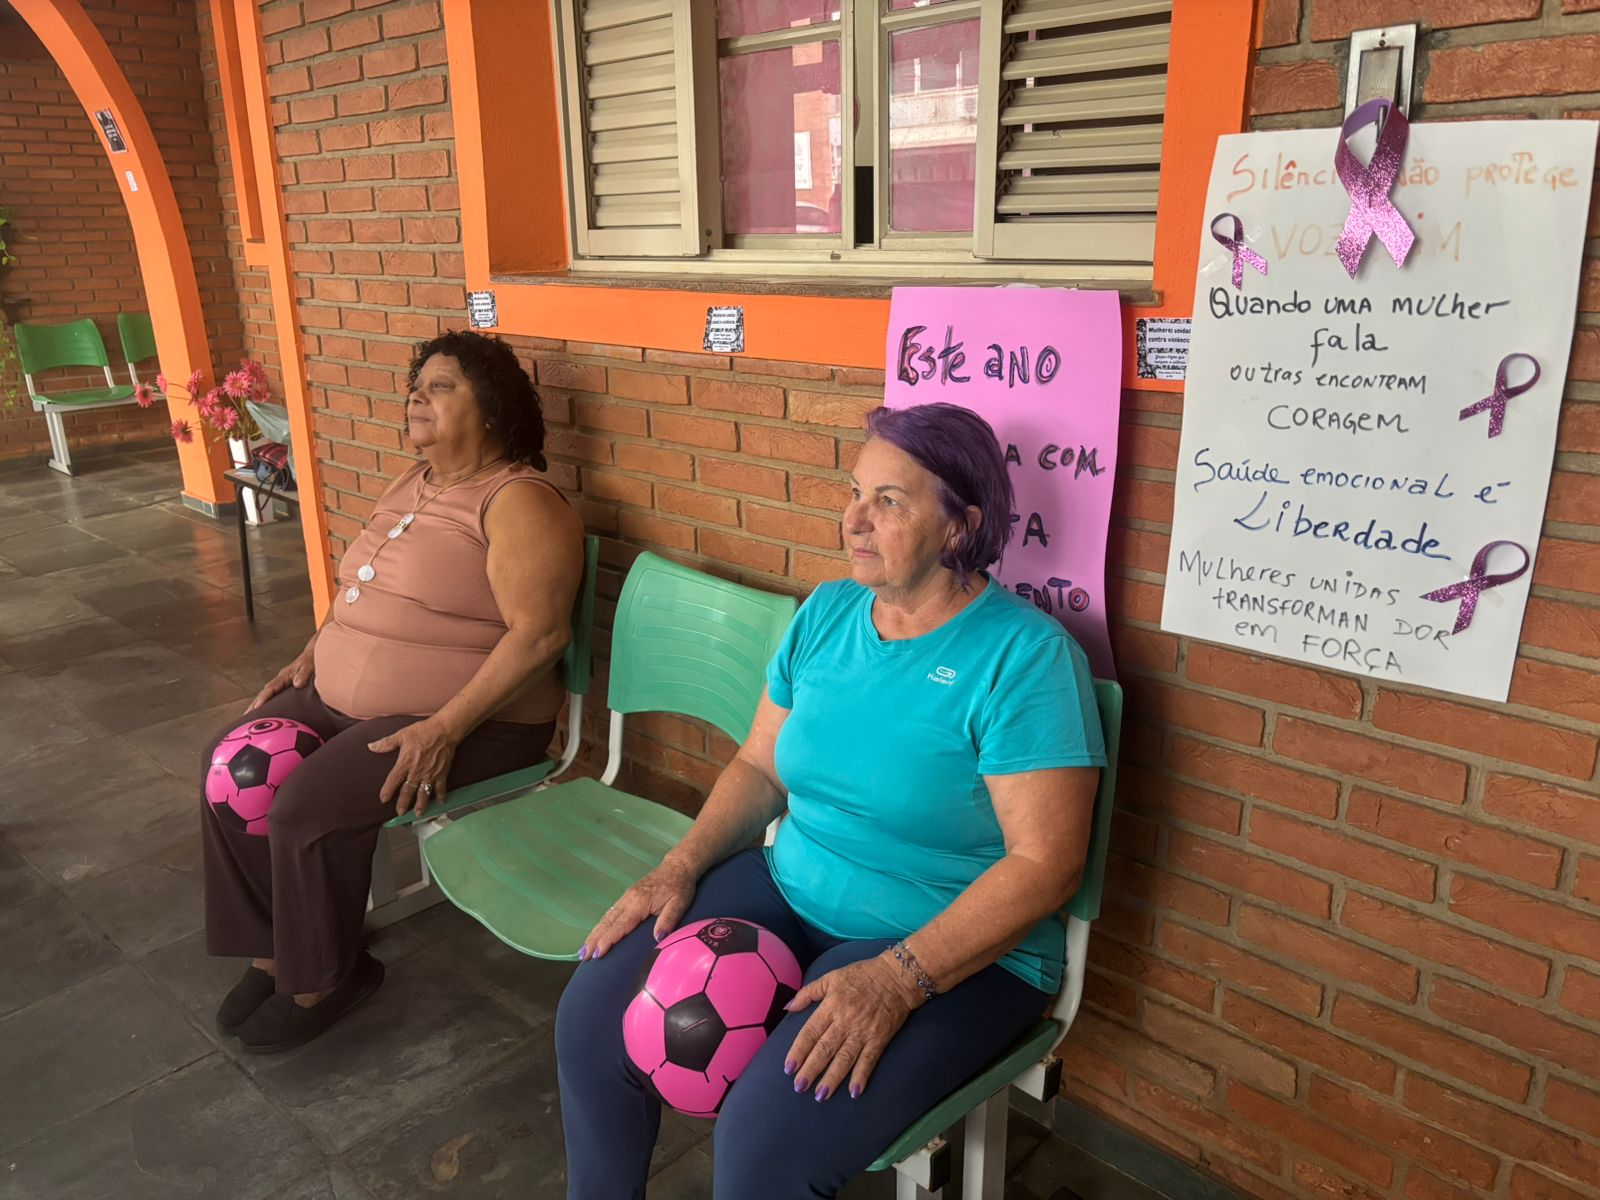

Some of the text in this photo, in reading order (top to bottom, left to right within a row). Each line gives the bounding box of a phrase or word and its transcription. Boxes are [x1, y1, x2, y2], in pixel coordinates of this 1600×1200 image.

[1226, 152, 1336, 202] Silênci
[1209, 286, 1312, 319] Quando
[1324, 296, 1373, 315] UMA
[897, 324, 972, 387] Este
[1310, 322, 1389, 368] fala
[1037, 443, 1107, 481] COM
[1193, 447, 1290, 493] Saúde
[1473, 481, 1511, 504] é
[1179, 550, 1297, 587] Mulheres
[1004, 576, 1090, 614] ENTO
[1302, 633, 1403, 674] FORÇA
[1393, 618, 1451, 651] DOR
